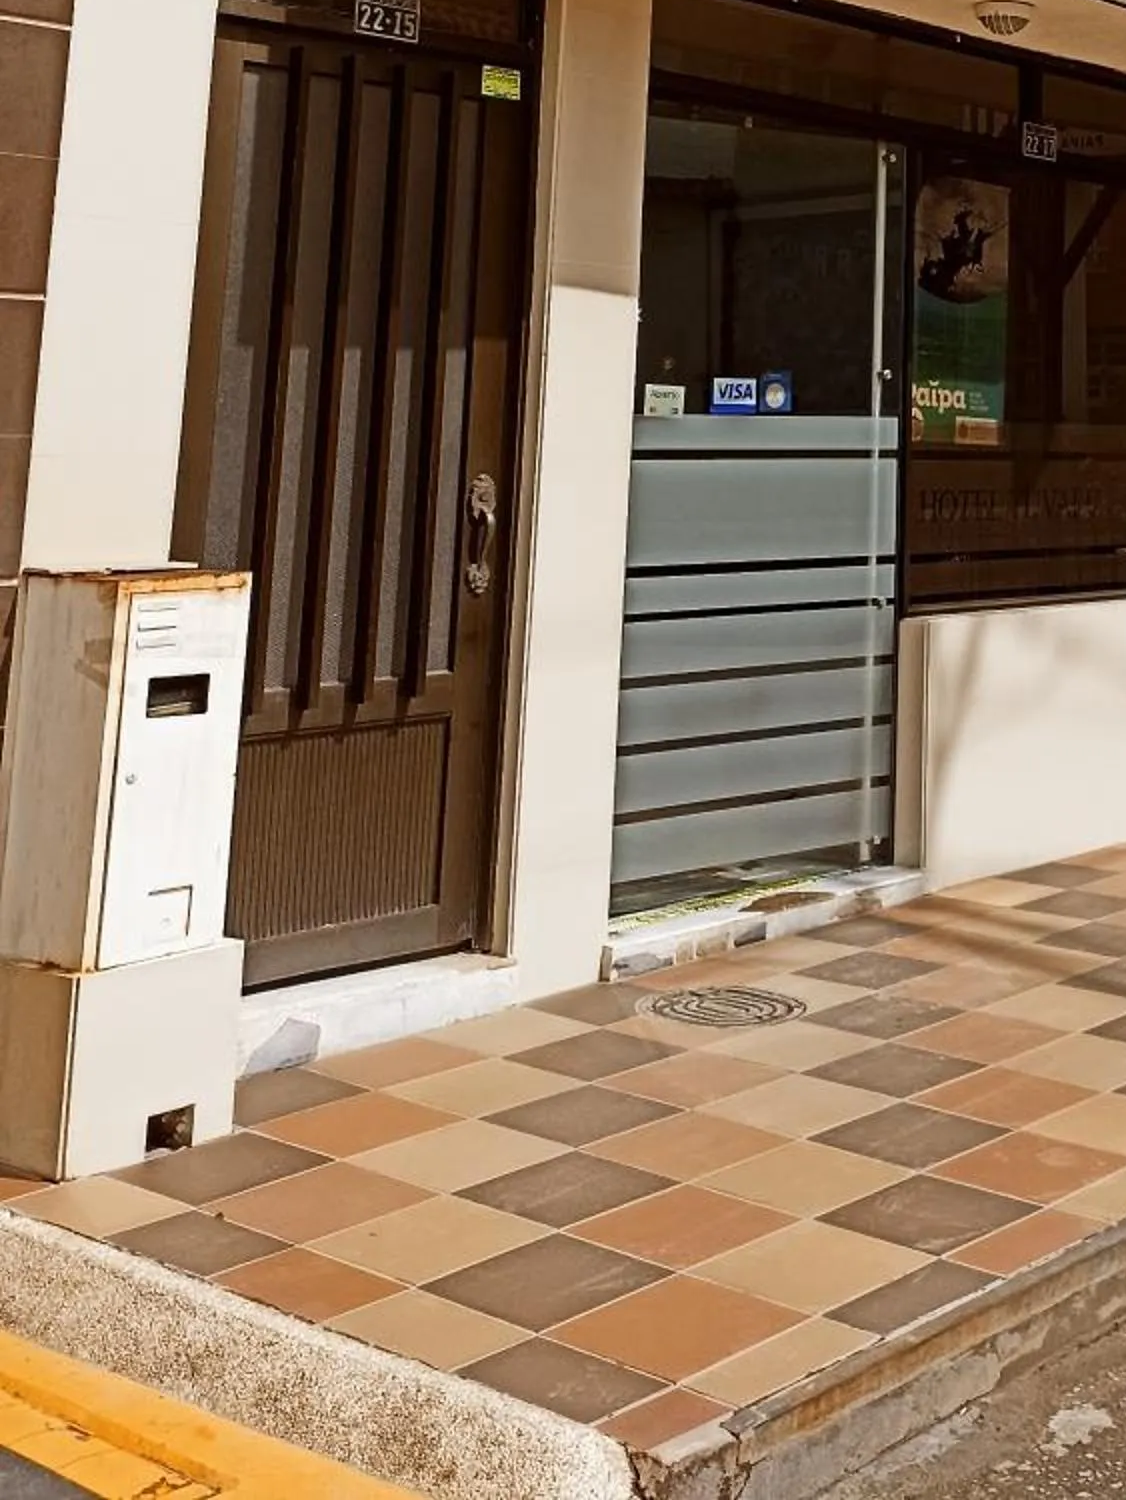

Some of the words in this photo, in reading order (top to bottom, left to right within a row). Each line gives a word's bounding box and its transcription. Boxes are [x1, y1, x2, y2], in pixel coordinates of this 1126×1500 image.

[1026, 135, 1056, 157] 2217
[718, 383, 753, 400] VISA
[918, 489, 1001, 523] HOTEL
